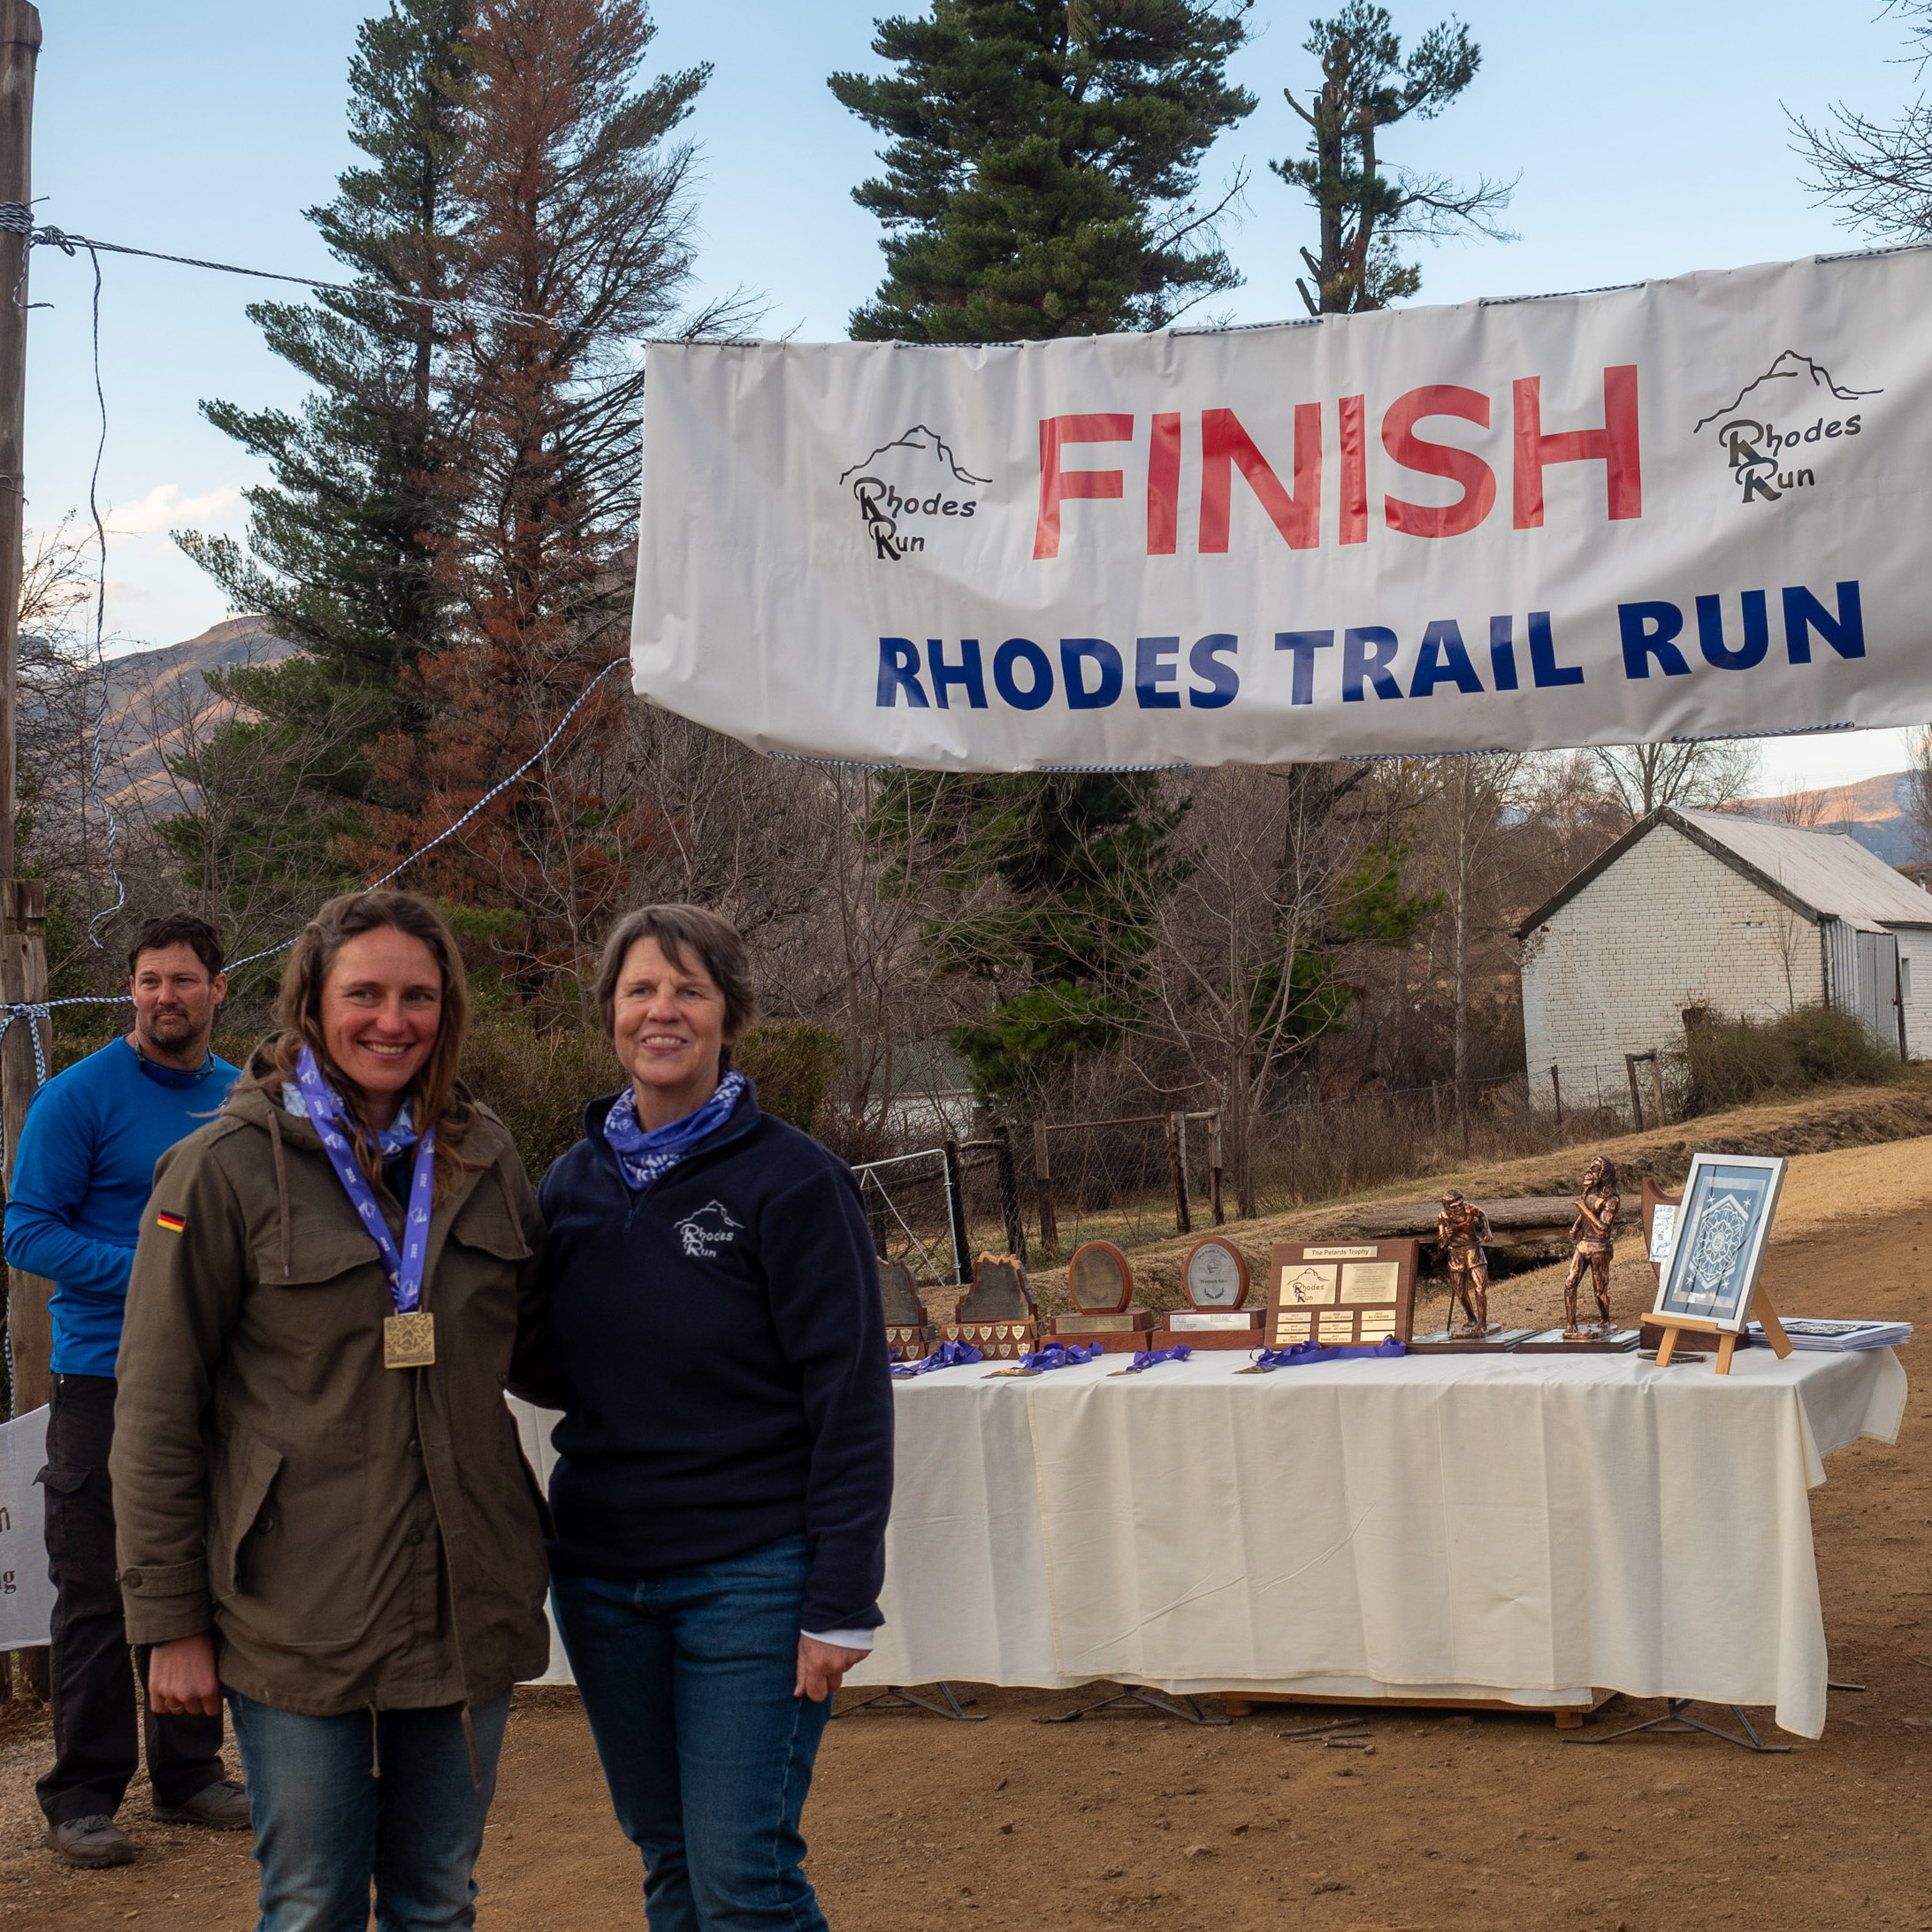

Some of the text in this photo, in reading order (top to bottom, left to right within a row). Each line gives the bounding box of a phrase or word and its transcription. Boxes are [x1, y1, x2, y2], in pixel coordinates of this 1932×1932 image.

[1033, 364, 1641, 561] FINISH
[1719, 413, 1861, 469] Rhodes
[854, 477, 976, 521] Rhodes
[1735, 461, 1814, 504] Run
[868, 515, 925, 561] Run
[875, 580, 1866, 709] RHODES TRAIL RUN
[680, 1224, 734, 1243] Rhodes
[683, 1240, 717, 1257] Run
[1293, 1282, 1325, 1294] Rhodes
[1295, 1291, 1313, 1302] Run
